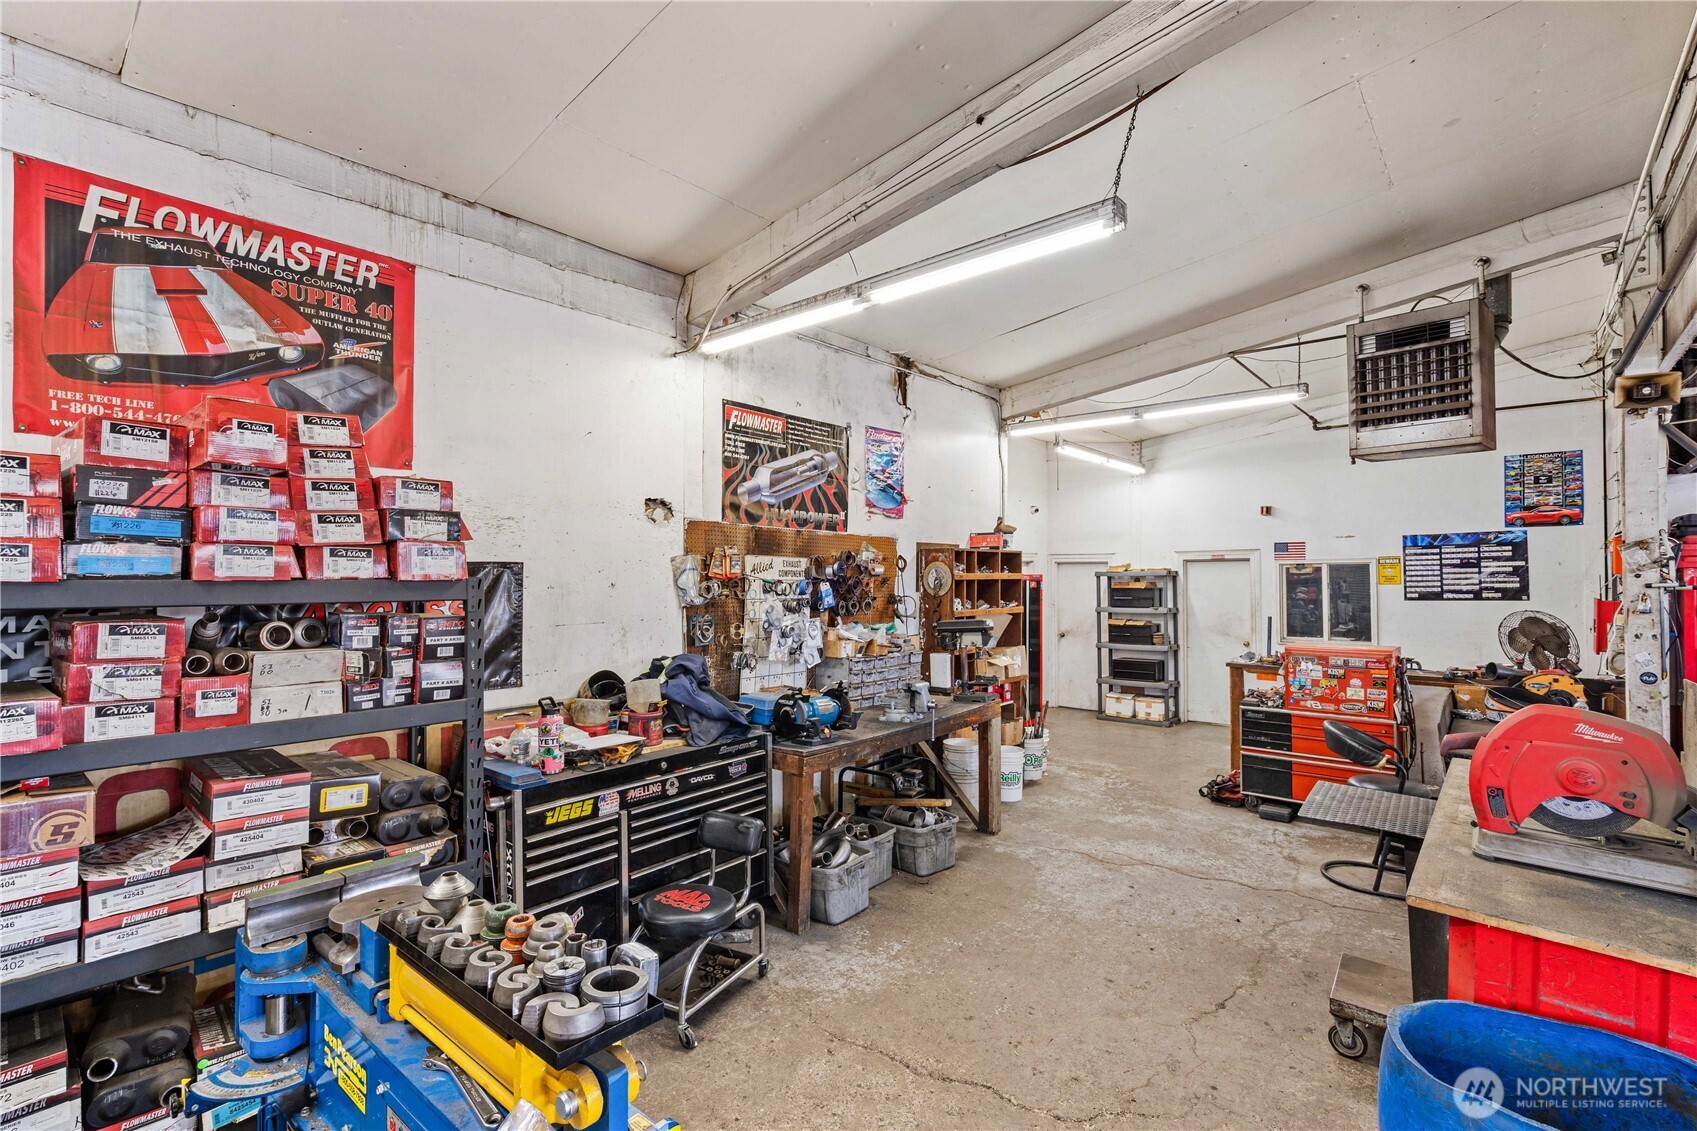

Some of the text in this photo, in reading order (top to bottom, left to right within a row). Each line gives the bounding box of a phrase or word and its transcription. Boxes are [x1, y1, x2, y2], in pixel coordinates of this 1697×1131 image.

[78, 184, 380, 289] FLOWMASTER
[111, 229, 141, 243] THE
[146, 237, 211, 259] EXHAUST
[214, 253, 300, 281] TECHNOLOGY
[271, 279, 393, 321] SUPER 40
[299, 306, 387, 331] THE MUFFLER FOR THE
[312, 319, 391, 340] OUTLAW GENERATION
[333, 341, 383, 357] AMERICAN
[335, 348, 381, 362] THUNDER
[48, 388, 155, 409] FREE TECH LINE
[729, 410, 782, 433] FLOWMASTER
[750, 559, 774, 576] Allied
[782, 559, 802, 568] EXHAUST
[132, 626, 159, 635] MAX
[128, 667, 156, 676] MAX
[120, 705, 149, 714] MAX
[1574, 723, 1624, 741] Milwaukee
[540, 738, 559, 746] YETI
[243, 779, 283, 792] FLOWMASTER
[690, 774, 714, 784] DAYCO
[630, 783, 662, 800] MELLING
[546, 799, 594, 825] JEGS
[243, 815, 284, 831] FLOWMASTER
[231, 880, 280, 903] FLOWMASTER
[122, 907, 168, 927] FLOWMASTER
[121, 1108, 167, 1131] FLOWMASTER
